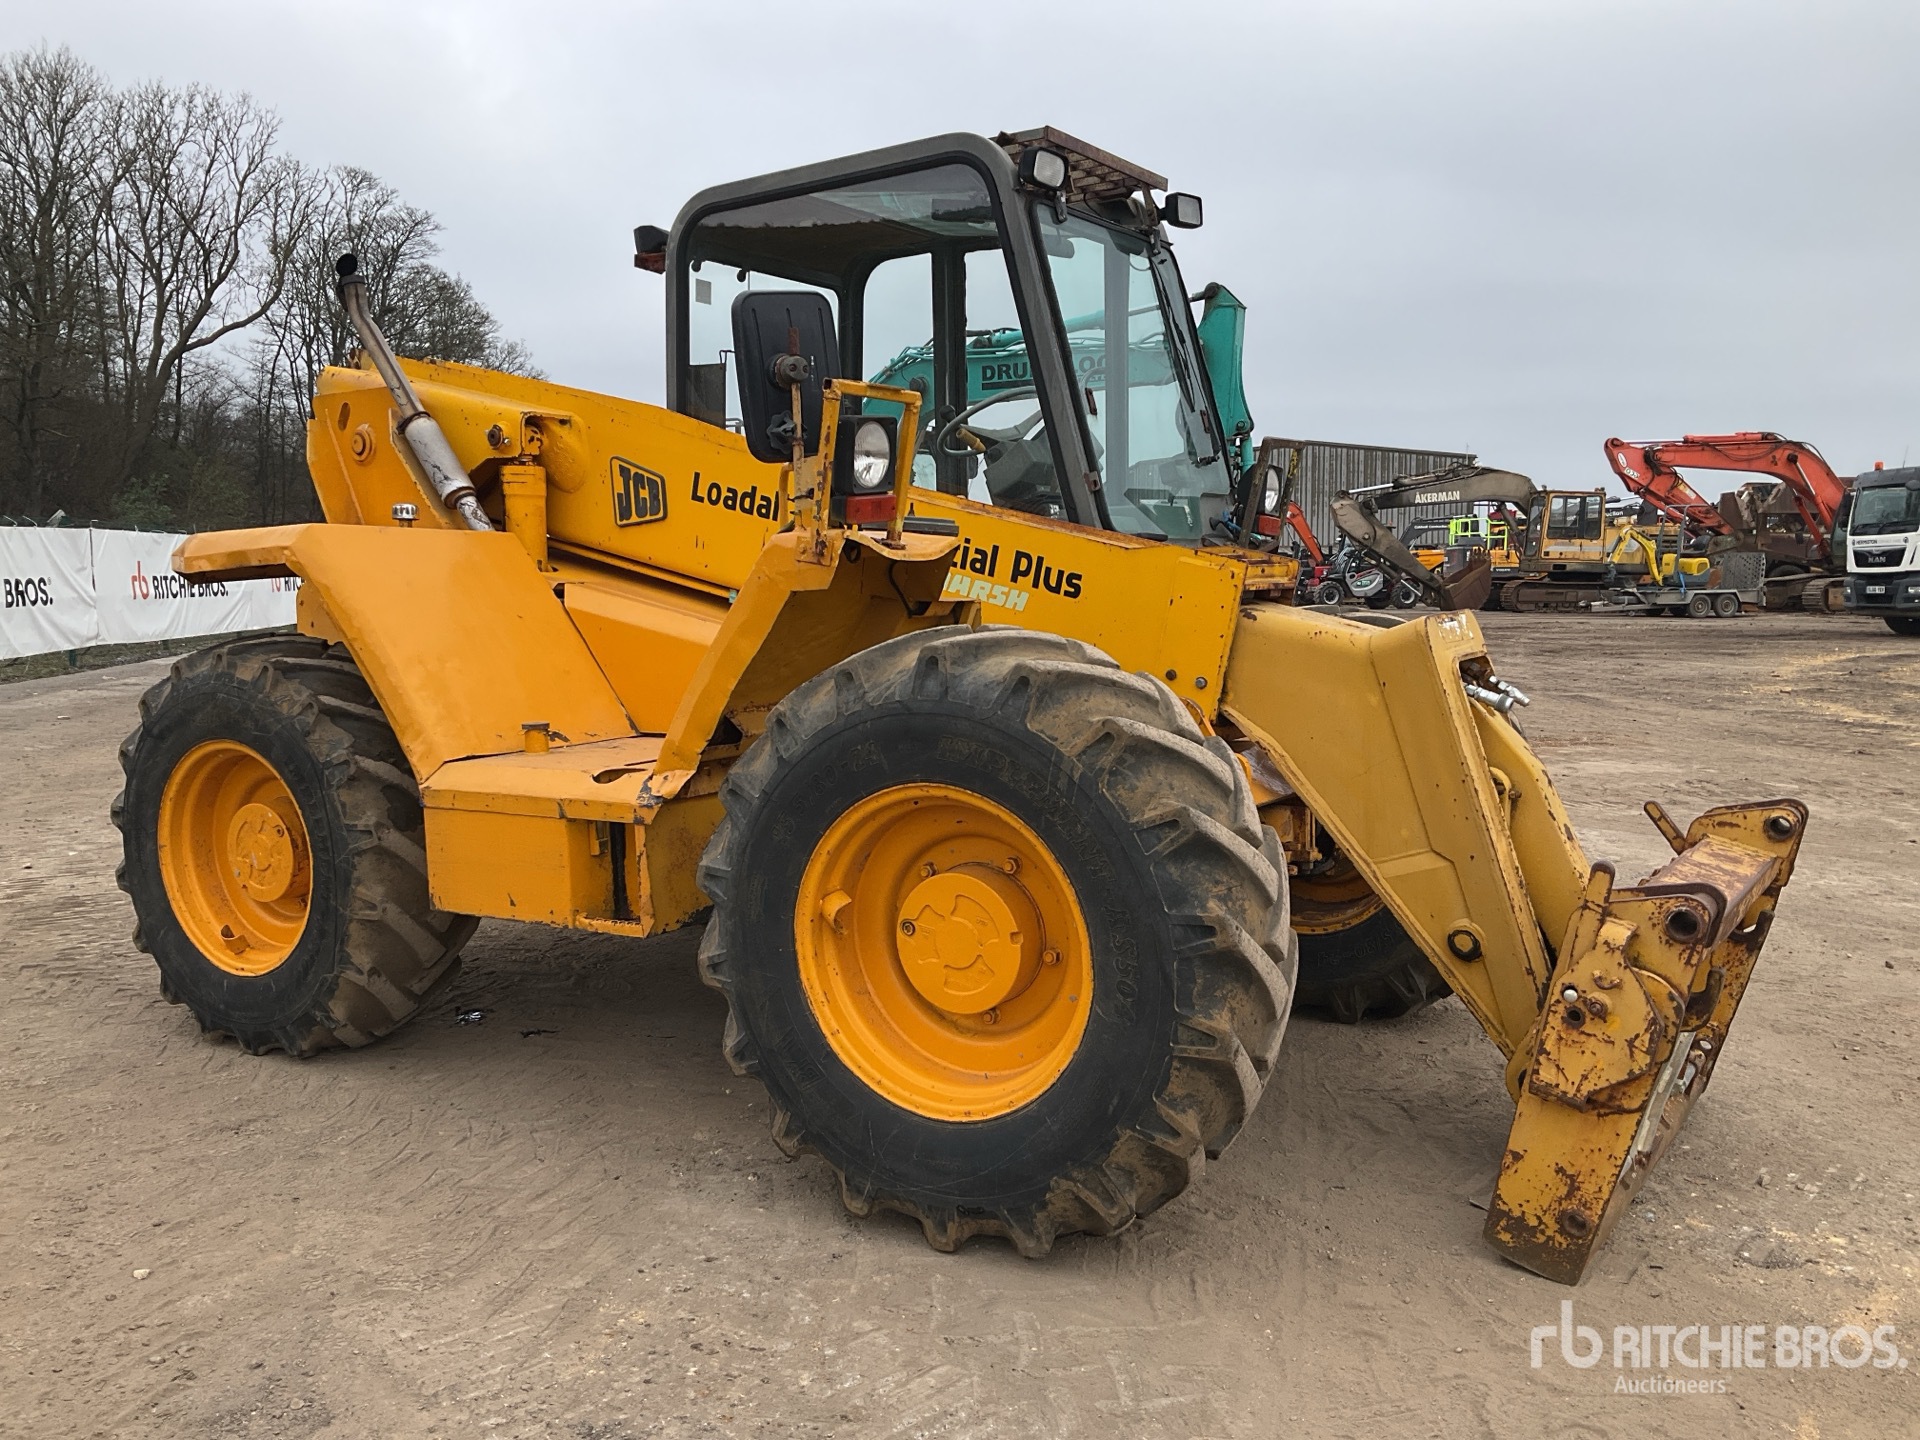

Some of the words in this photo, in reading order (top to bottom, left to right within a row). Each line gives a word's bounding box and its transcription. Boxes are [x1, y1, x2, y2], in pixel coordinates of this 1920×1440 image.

[617, 464, 661, 522] JCB
[1414, 490, 1461, 504] ÅKERMAN
[691, 472, 780, 522] Loadal
[1010, 550, 1083, 599] Plus
[3, 577, 54, 608] BROS.
